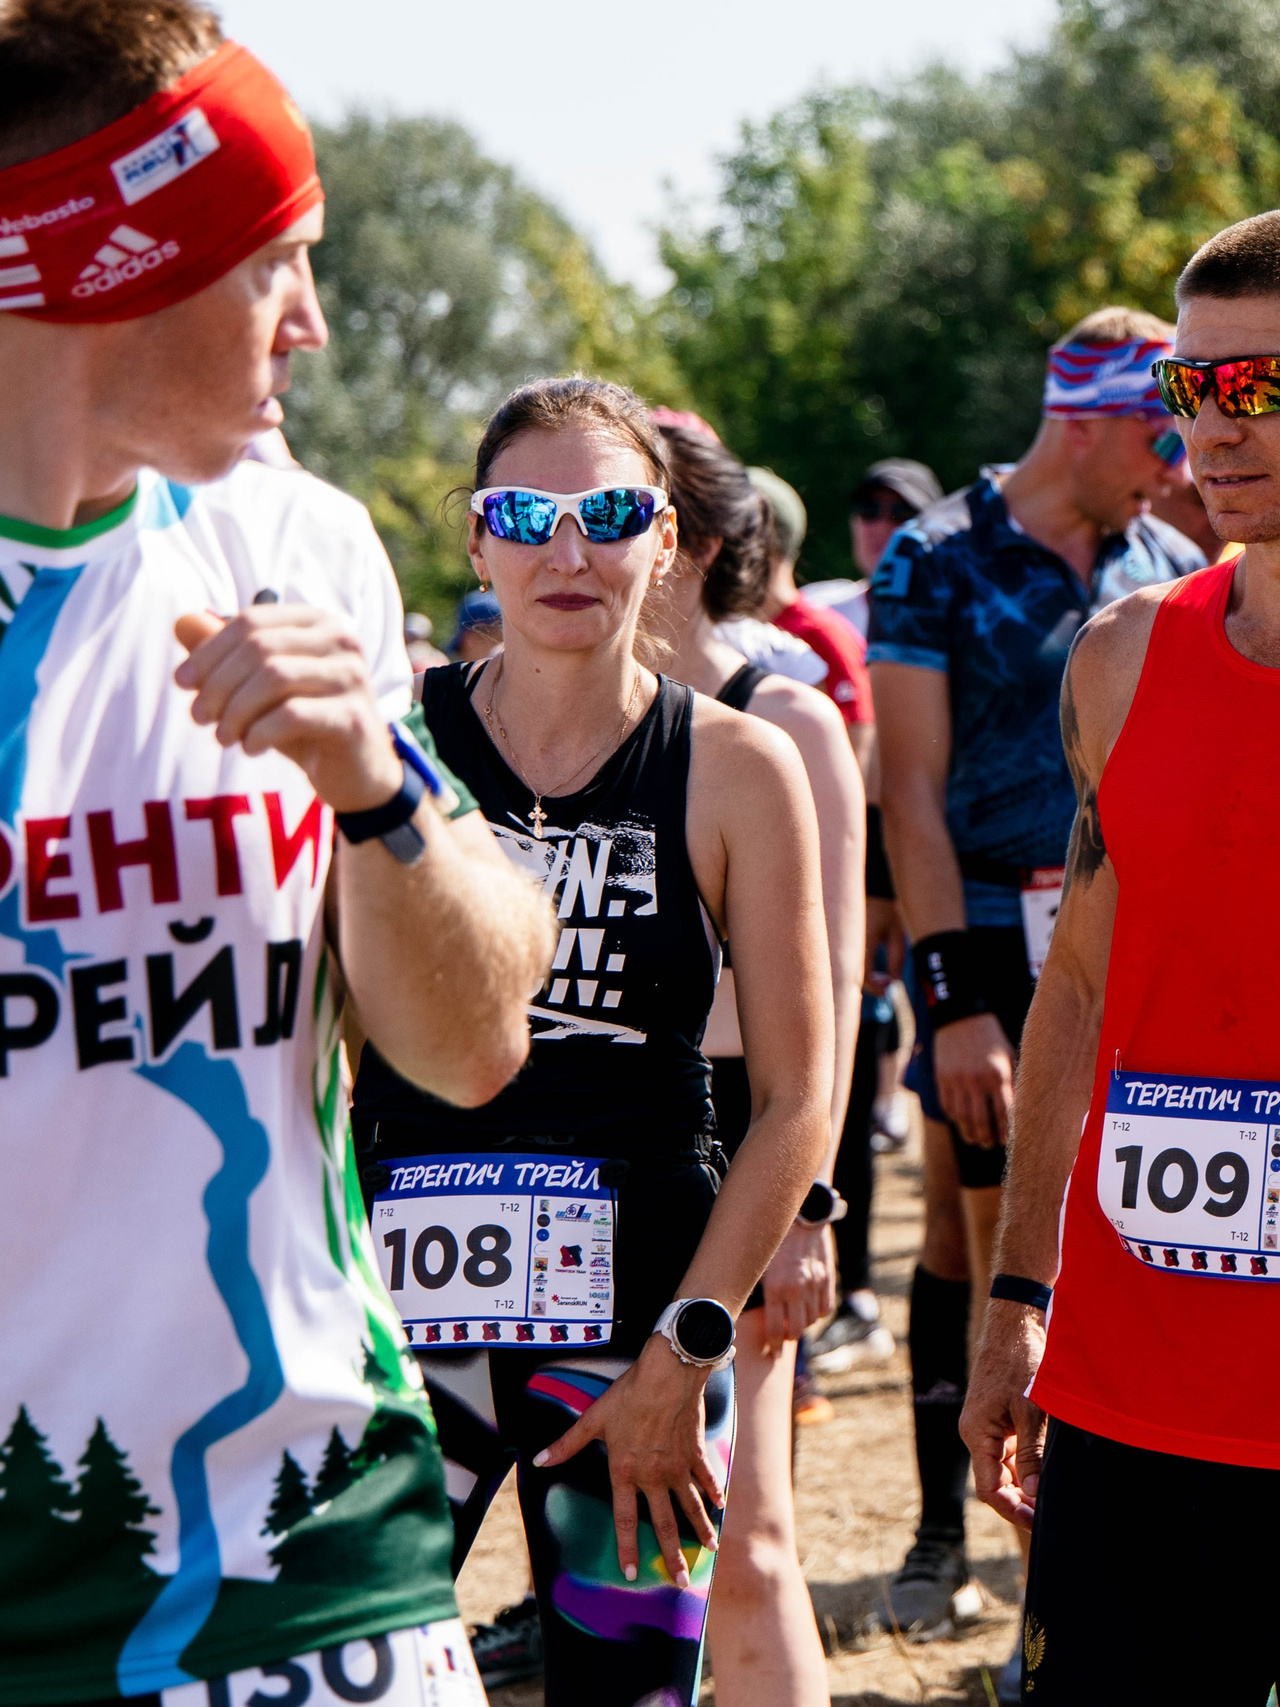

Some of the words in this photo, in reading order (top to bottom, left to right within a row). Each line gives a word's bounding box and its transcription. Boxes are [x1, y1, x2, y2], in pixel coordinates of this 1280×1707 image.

[72, 240, 181, 298] adidas
[0, 791, 327, 923] ЕНТИ
[1125, 1082, 1242, 1112] ТЕРЕНТИЧ
[391, 1162, 504, 1191] ТЕРЕНТИЧ
[514, 1160, 600, 1191] ТРЕЙЛ
[1115, 1145, 1250, 1218] 109
[383, 1223, 513, 1292] 108
